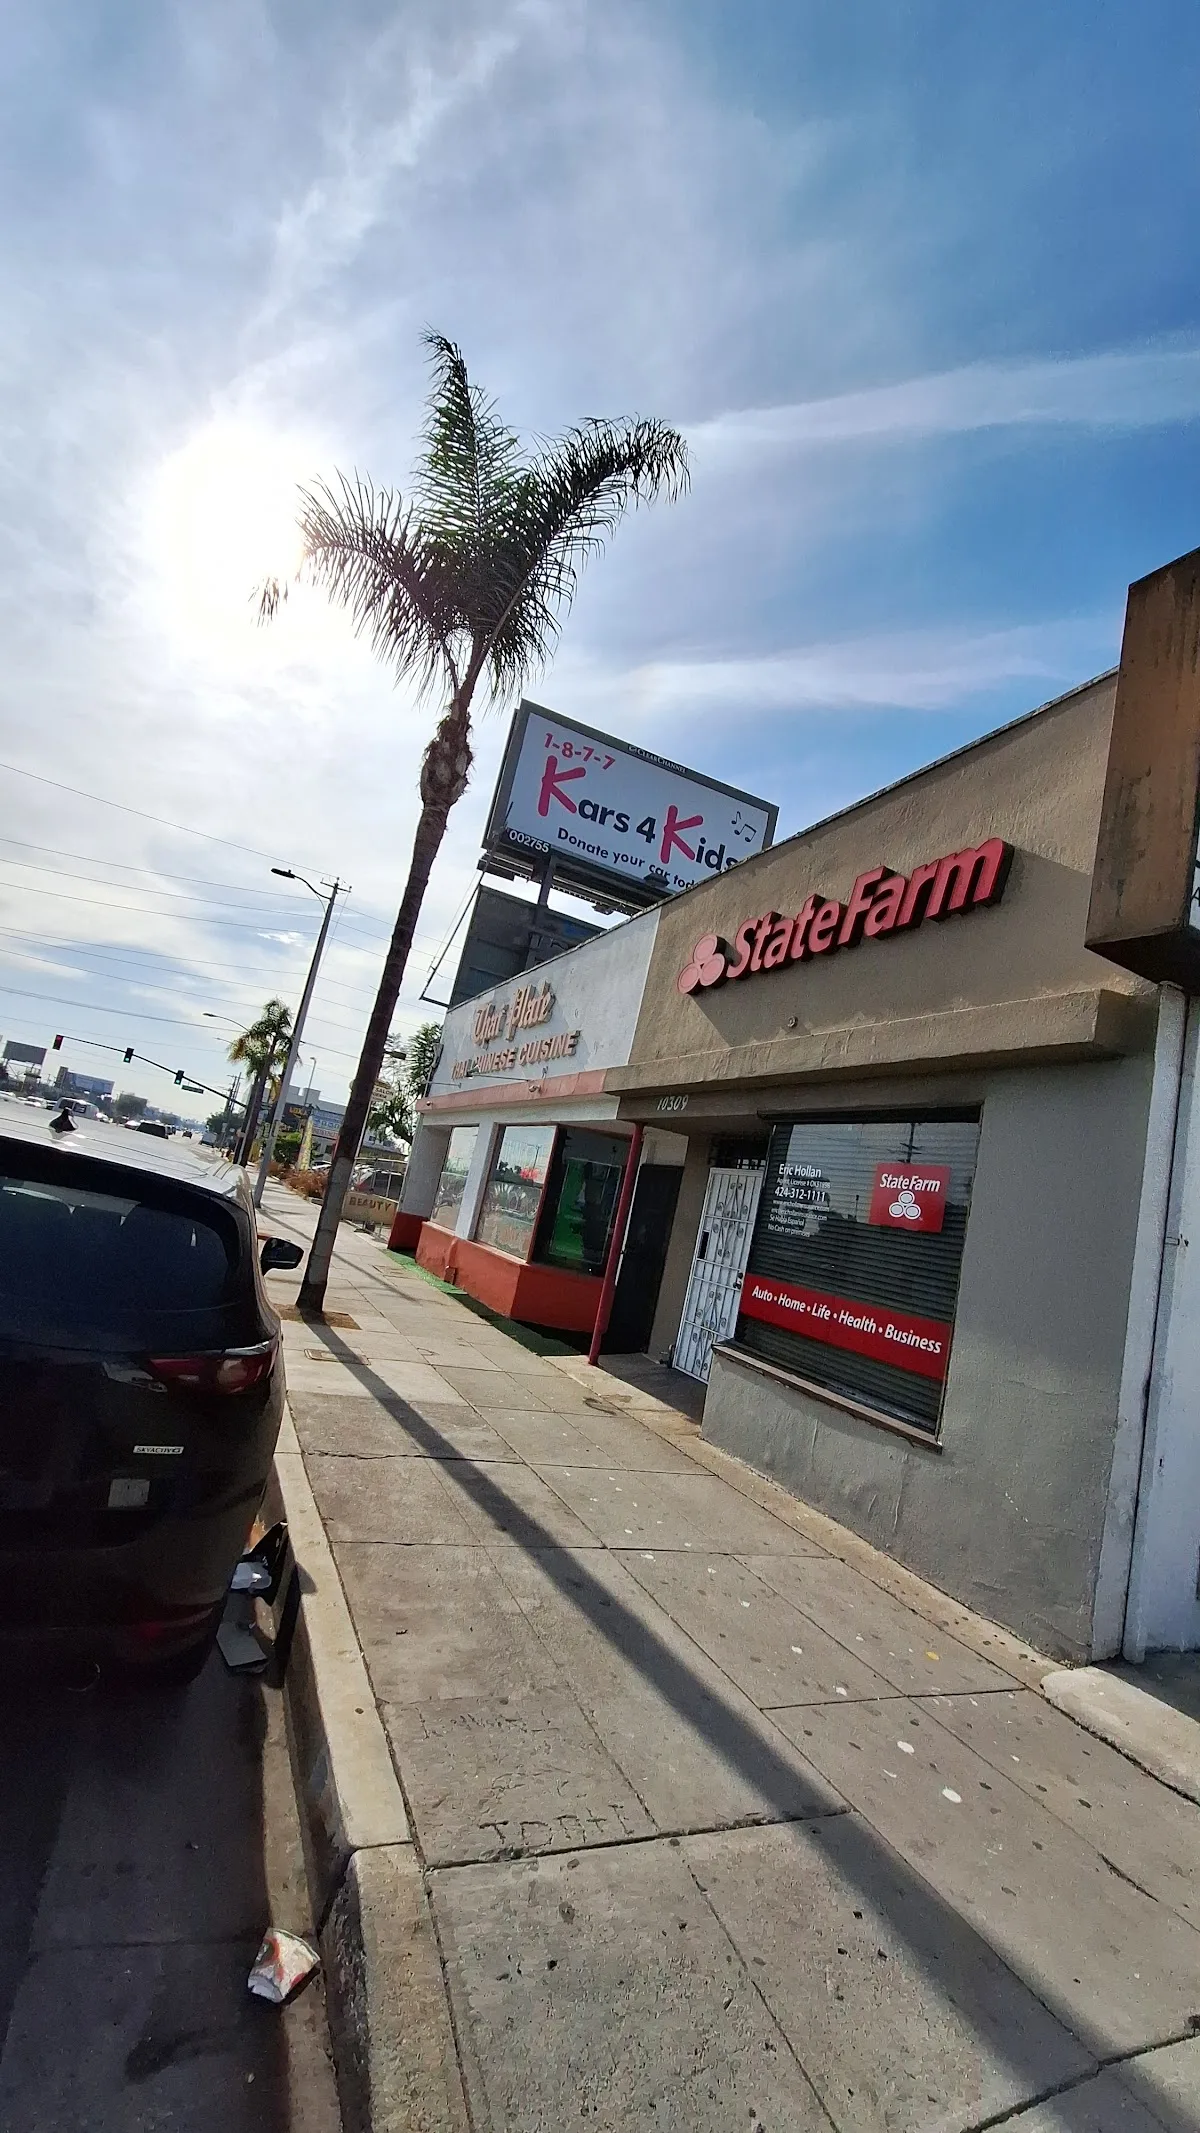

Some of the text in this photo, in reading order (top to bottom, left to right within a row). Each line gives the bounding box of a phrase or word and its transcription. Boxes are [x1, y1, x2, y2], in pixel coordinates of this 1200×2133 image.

[544, 732, 616, 770] 1-8-7-7
[538, 755, 632, 833] Kars
[635, 816, 657, 844] 4
[508, 829, 551, 854] 002755
[557, 827, 696, 889] Donate your car tod
[519, 1030, 581, 1066] CUISINE
[656, 1094, 689, 1111] 10309
[778, 1163, 822, 1178] Eric Hollan
[348, 1196, 392, 1211] BEAUTY
[774, 1186, 826, 1202] 424-312-1111
[774, 1224, 785, 1232] Cash
[751, 1285, 942, 1354] Auto Home Life Health Business
